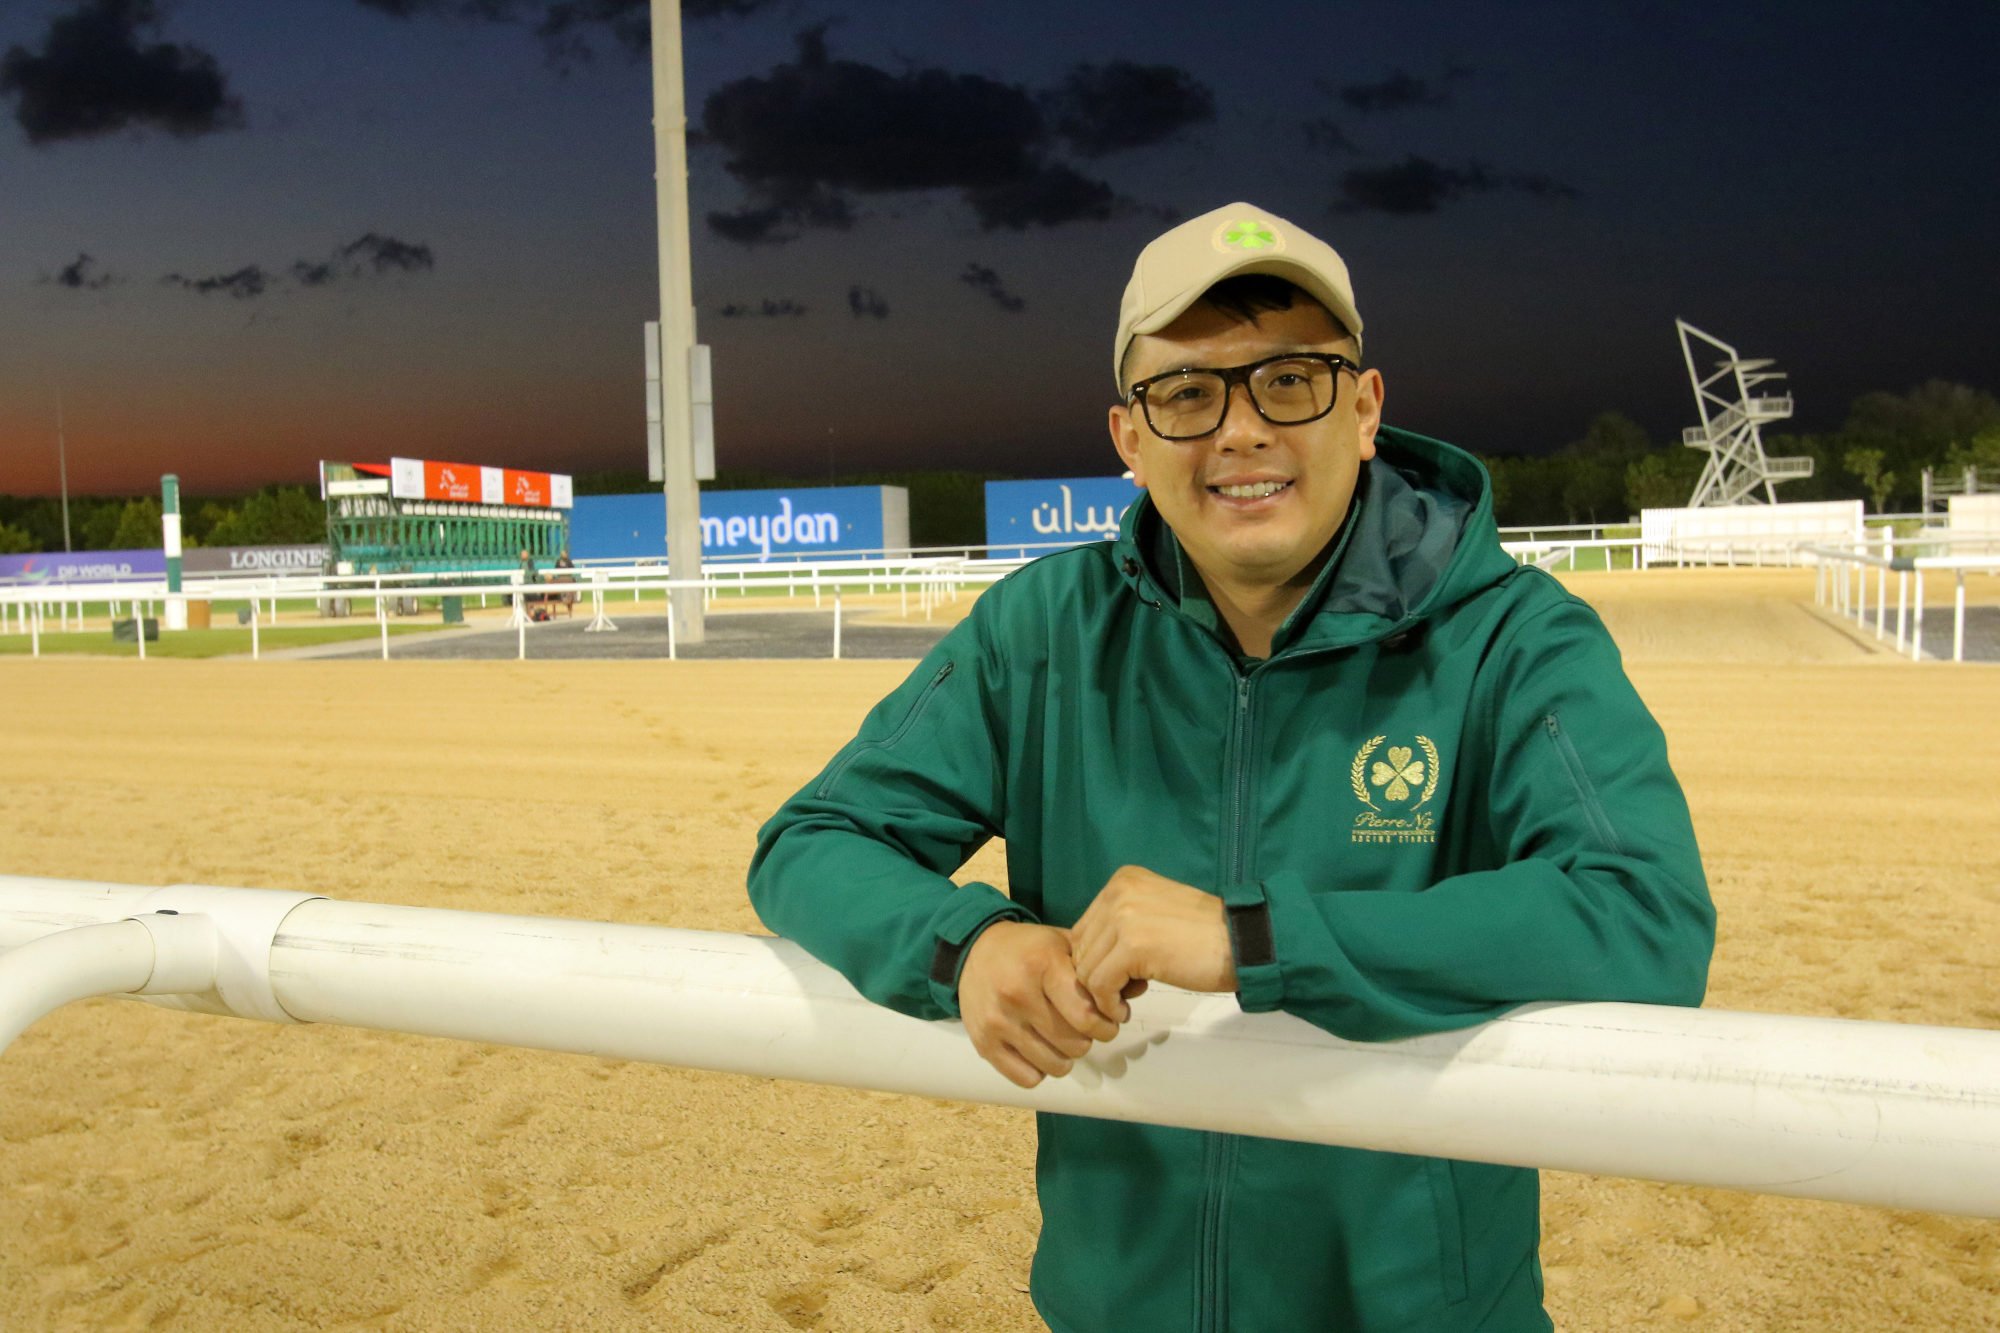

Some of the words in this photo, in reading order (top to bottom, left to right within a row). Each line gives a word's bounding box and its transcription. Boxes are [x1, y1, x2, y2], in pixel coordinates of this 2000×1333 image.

[1032, 485, 1129, 540] يدان
[699, 497, 839, 563] meydan
[58, 565, 77, 578] DP
[80, 564, 132, 577] WORLD
[1399, 835, 1435, 843] STABLE
